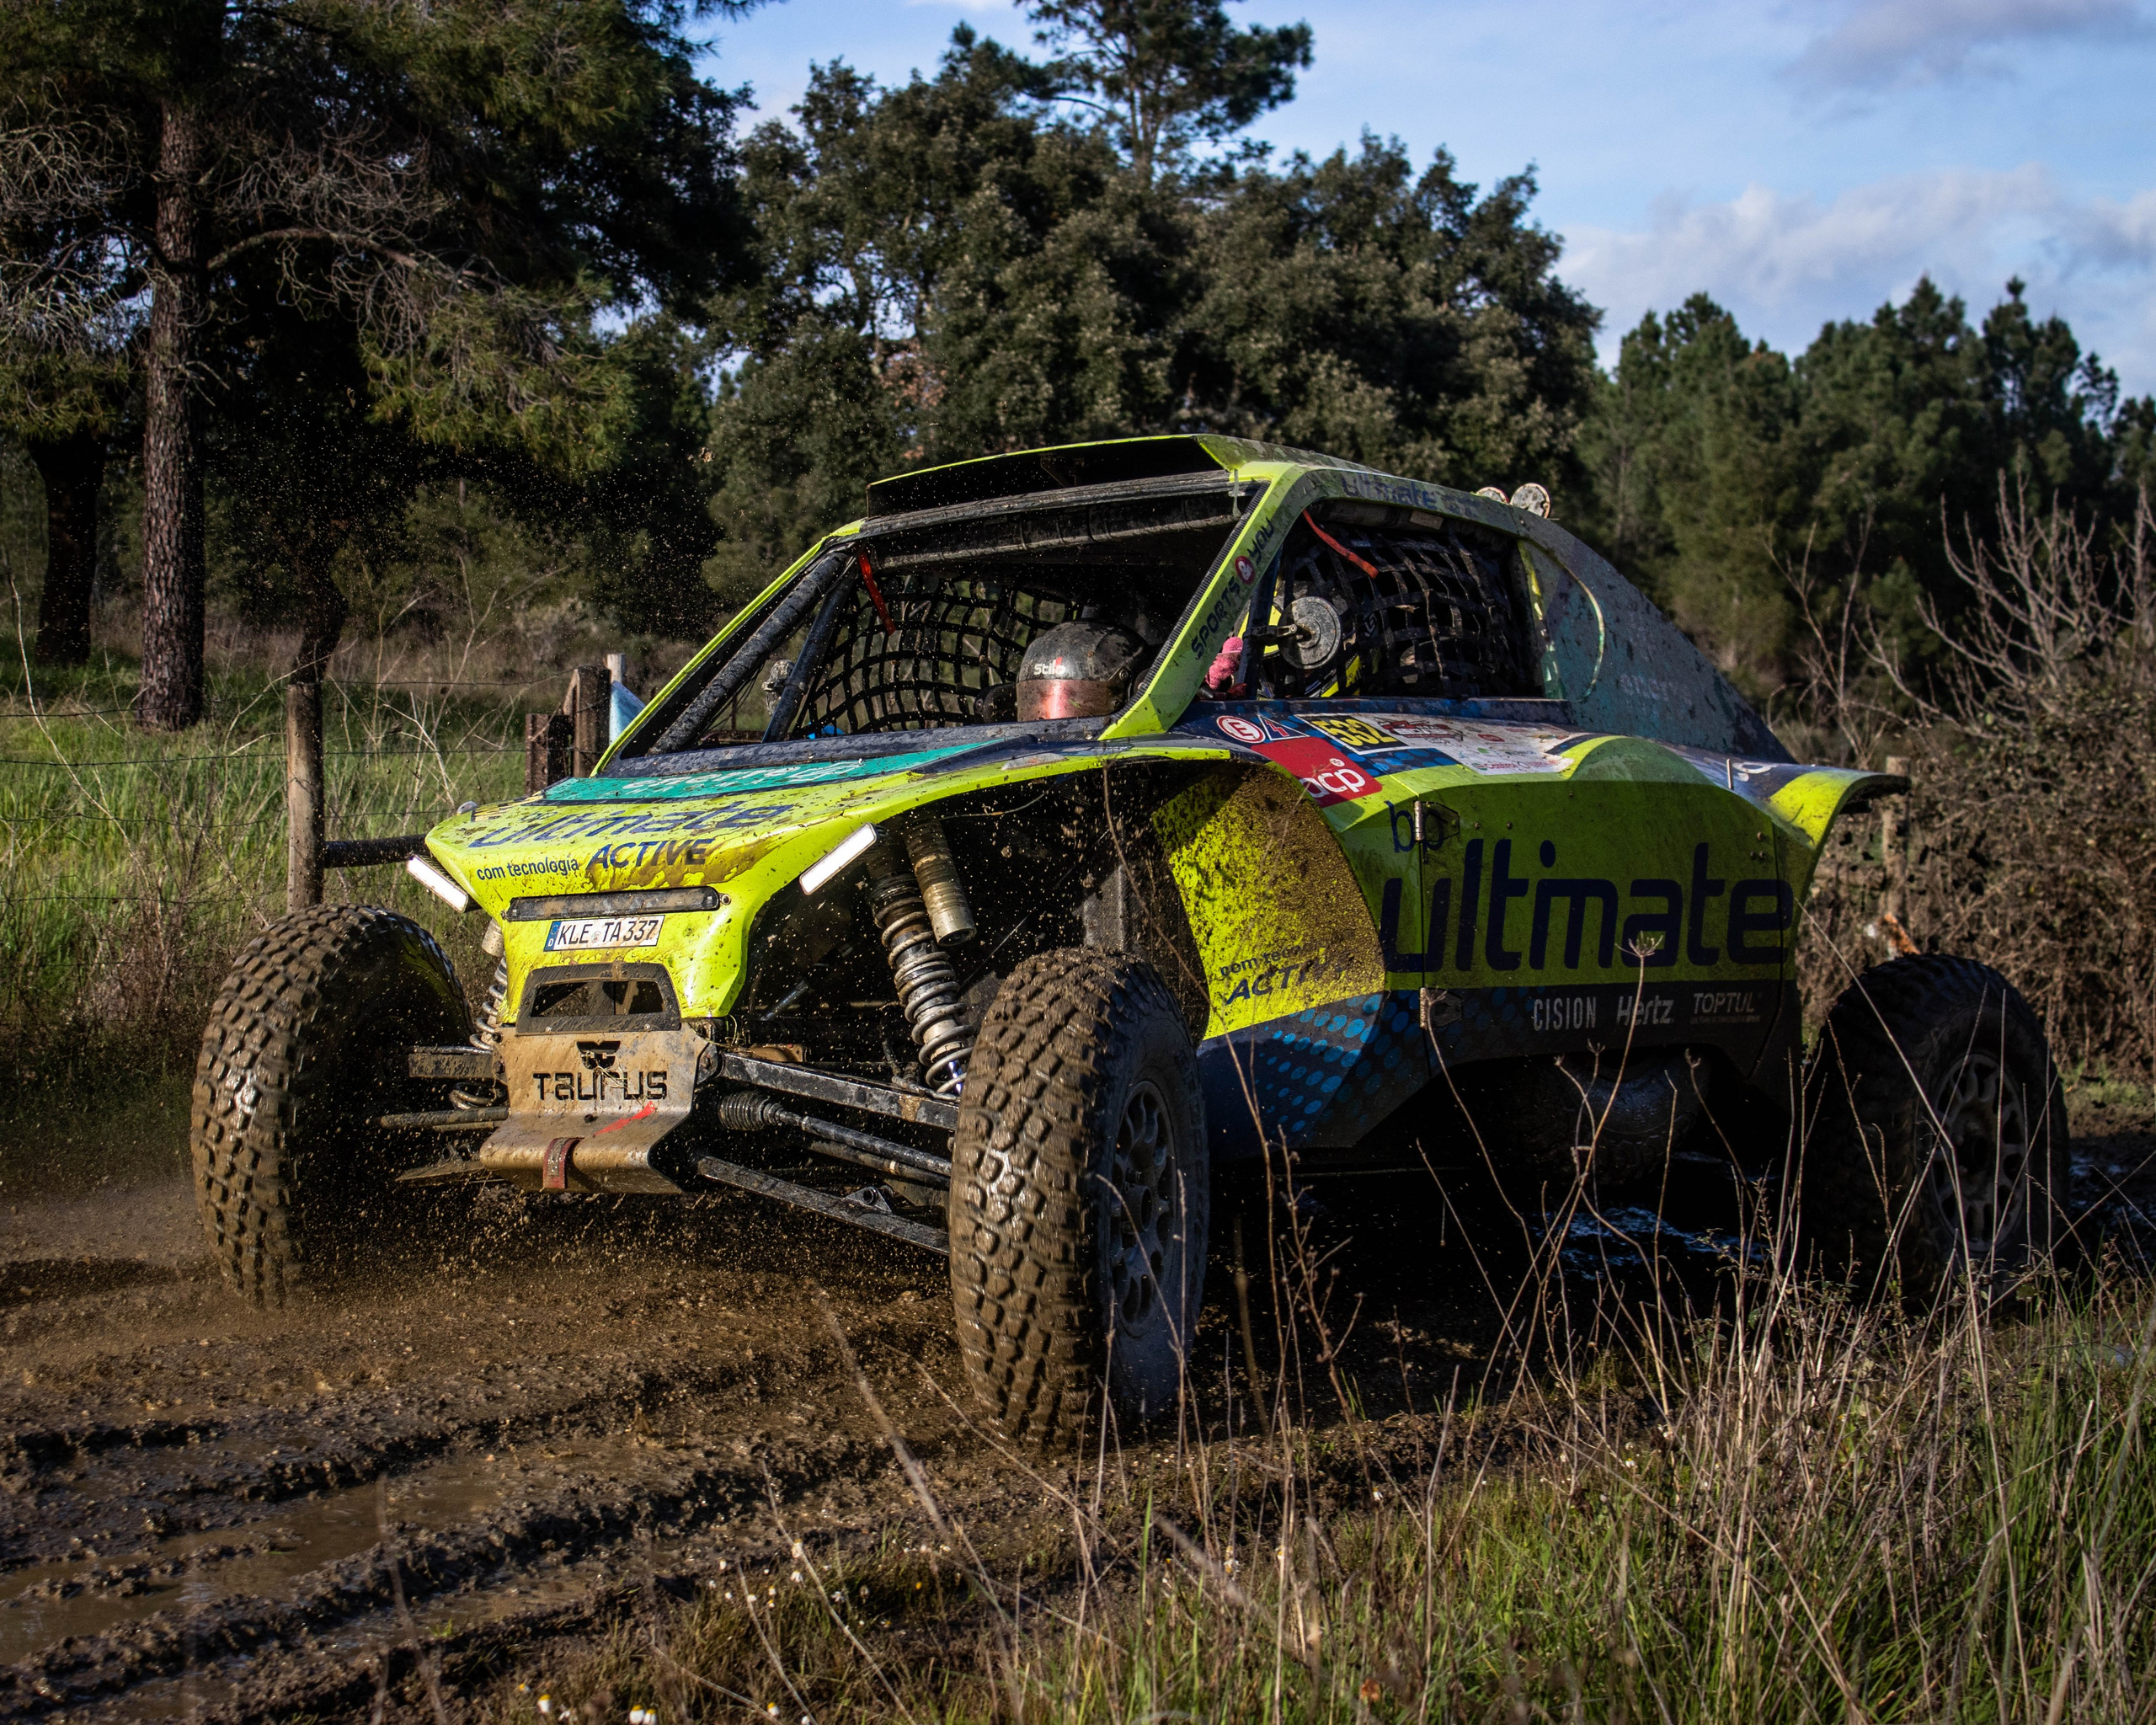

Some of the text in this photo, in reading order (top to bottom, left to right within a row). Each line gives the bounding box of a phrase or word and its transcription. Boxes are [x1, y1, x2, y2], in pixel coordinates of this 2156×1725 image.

[1311, 718, 1398, 746] 532
[468, 800, 794, 848] ultimate
[1384, 800, 1444, 863] bp
[476, 861, 506, 881] com
[586, 838, 716, 869] ACTIVE
[1382, 839, 1796, 974] ultimate
[558, 923, 593, 945] KLE
[602, 921, 622, 943] TA
[623, 919, 659, 942] 337
[1533, 996, 1597, 1031] CISION
[1616, 995, 1674, 1027] Hertz
[1693, 992, 1755, 1015] TOPTUL
